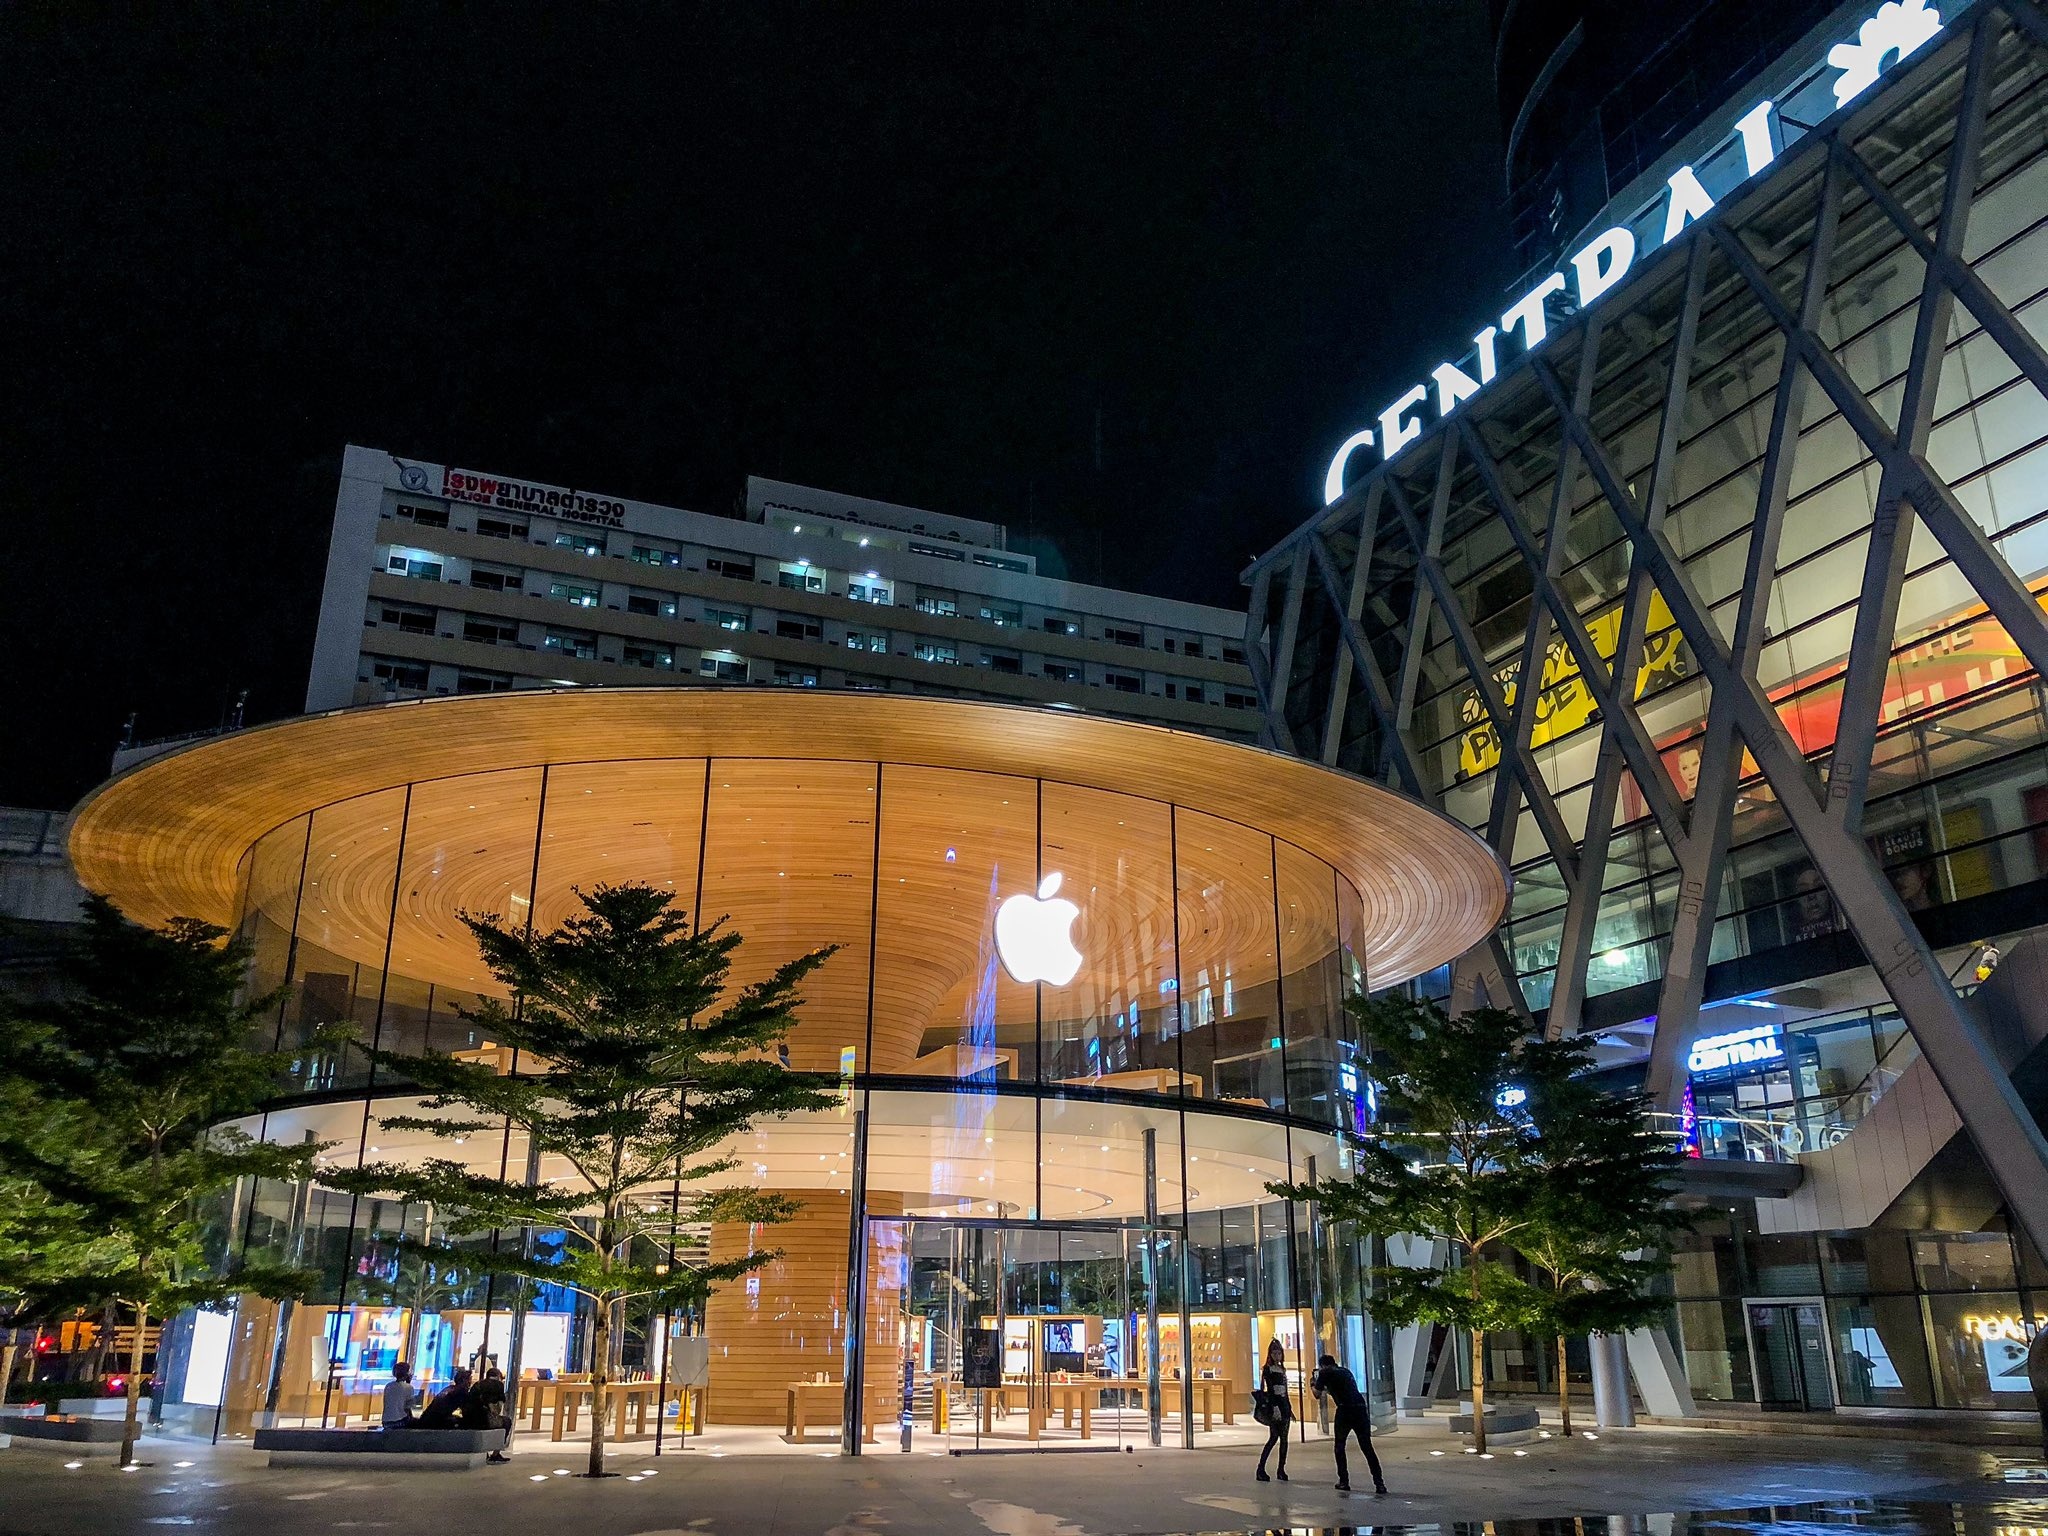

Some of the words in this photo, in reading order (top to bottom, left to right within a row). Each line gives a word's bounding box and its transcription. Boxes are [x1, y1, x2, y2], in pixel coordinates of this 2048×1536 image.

[442, 487, 491, 505] POLICE
[496, 498, 557, 517] GENERAL
[562, 509, 625, 529] HOSPITAL
